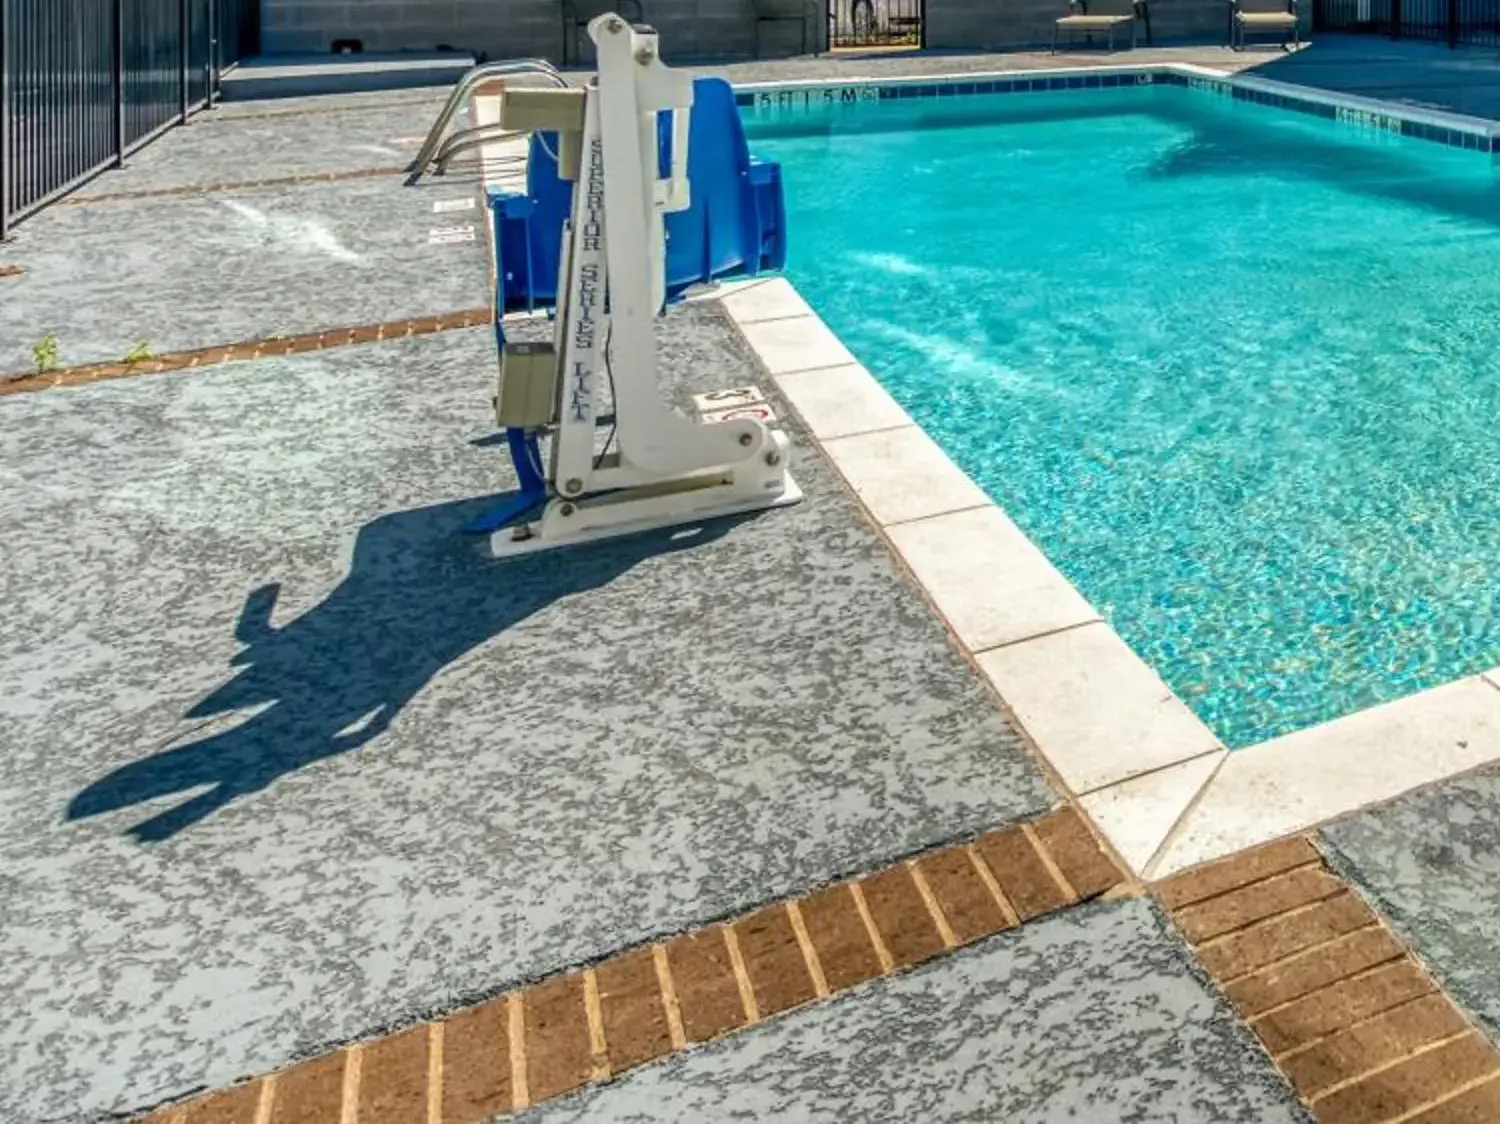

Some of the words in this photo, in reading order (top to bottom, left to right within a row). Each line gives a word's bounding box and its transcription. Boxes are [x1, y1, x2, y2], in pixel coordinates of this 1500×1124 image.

[841, 87, 857, 103] M
[576, 263, 599, 349] SERIES
[571, 362, 591, 421] LIFT
